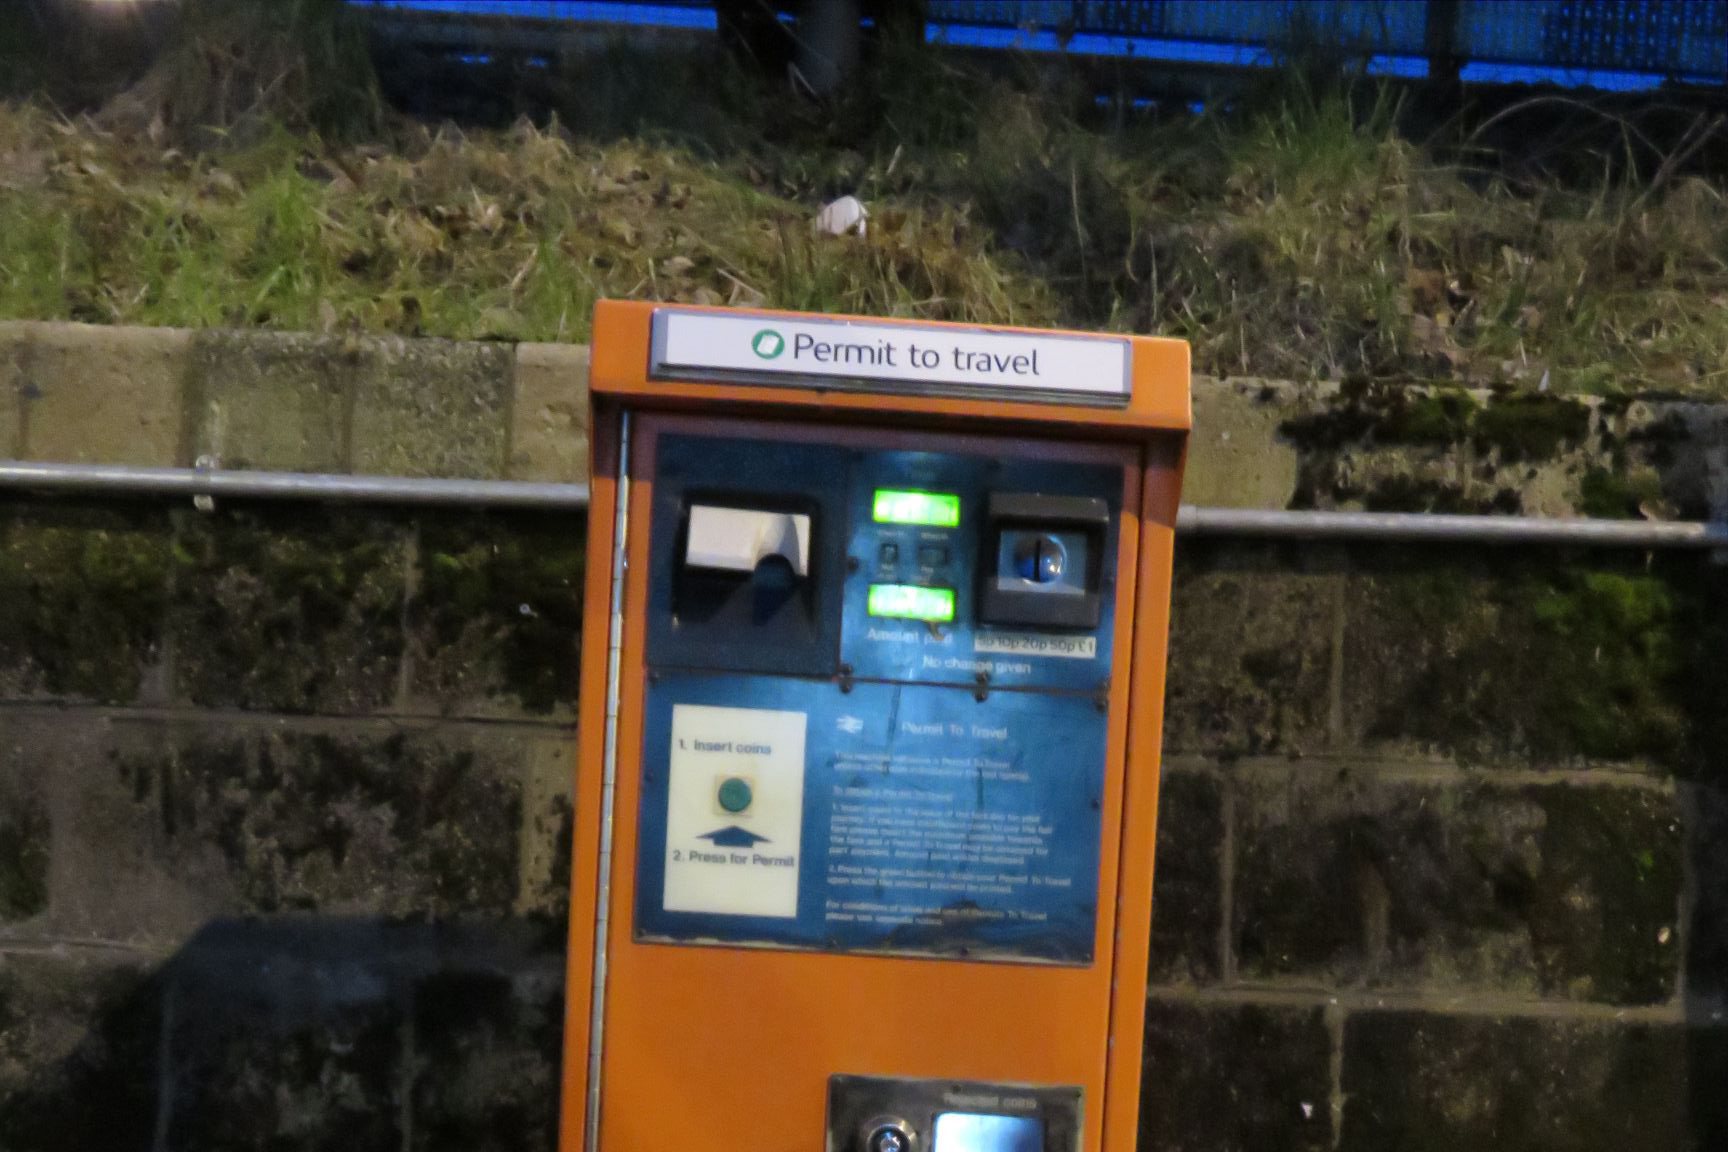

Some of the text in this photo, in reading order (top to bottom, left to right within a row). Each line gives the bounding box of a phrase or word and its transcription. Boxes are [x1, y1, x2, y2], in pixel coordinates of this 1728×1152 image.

[794, 333, 1040, 376] Permit to travel
[867, 628, 953, 647] Amount pd
[1022, 636, 1047, 650] 20p
[1050, 639, 1075, 652] 50p
[923, 656, 1031, 675] No change given
[902, 721, 1007, 740] Permit To Travel
[679, 739, 771, 755] 1. Insert coins
[673, 850, 794, 867] 2. Press for Permit
